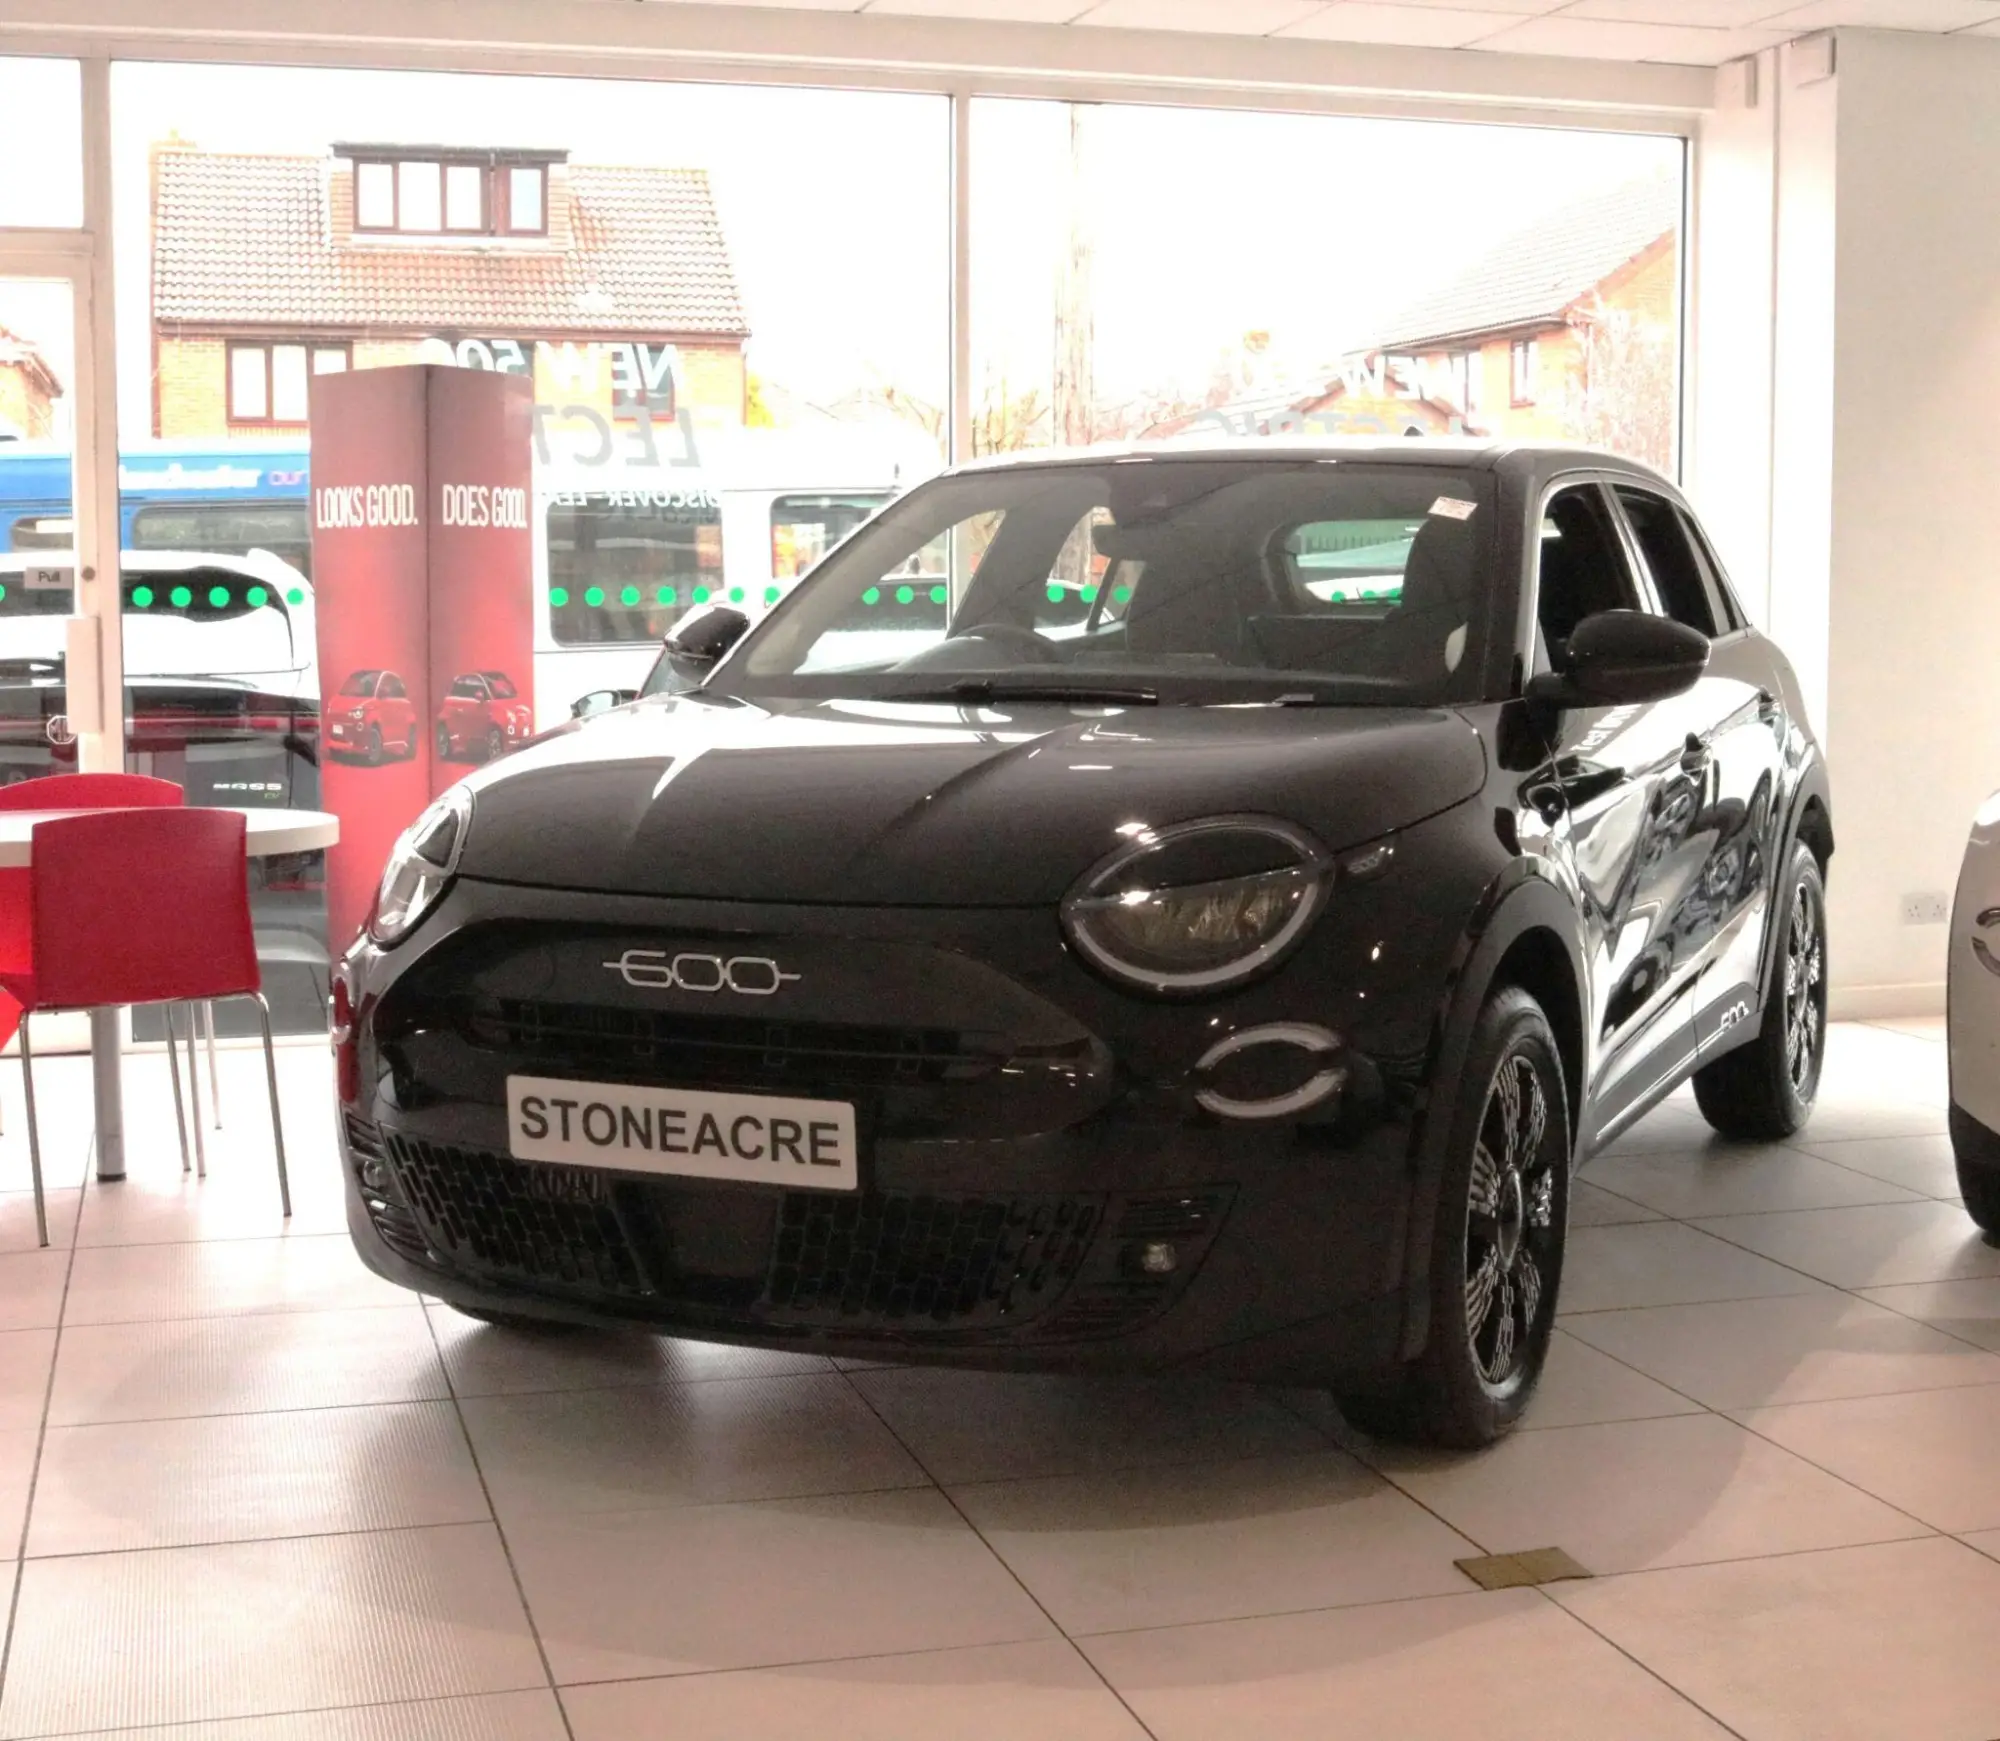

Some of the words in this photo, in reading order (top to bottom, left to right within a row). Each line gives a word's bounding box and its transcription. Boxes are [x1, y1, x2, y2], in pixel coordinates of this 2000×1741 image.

[316, 486, 363, 529] LOOKS
[366, 484, 418, 527] GOOD.
[442, 484, 489, 527] DOES
[492, 486, 528, 528] GOOD.
[38, 570, 61, 583] Pull
[604, 949, 800, 995] 600
[520, 1095, 842, 1168] STONEACRE
